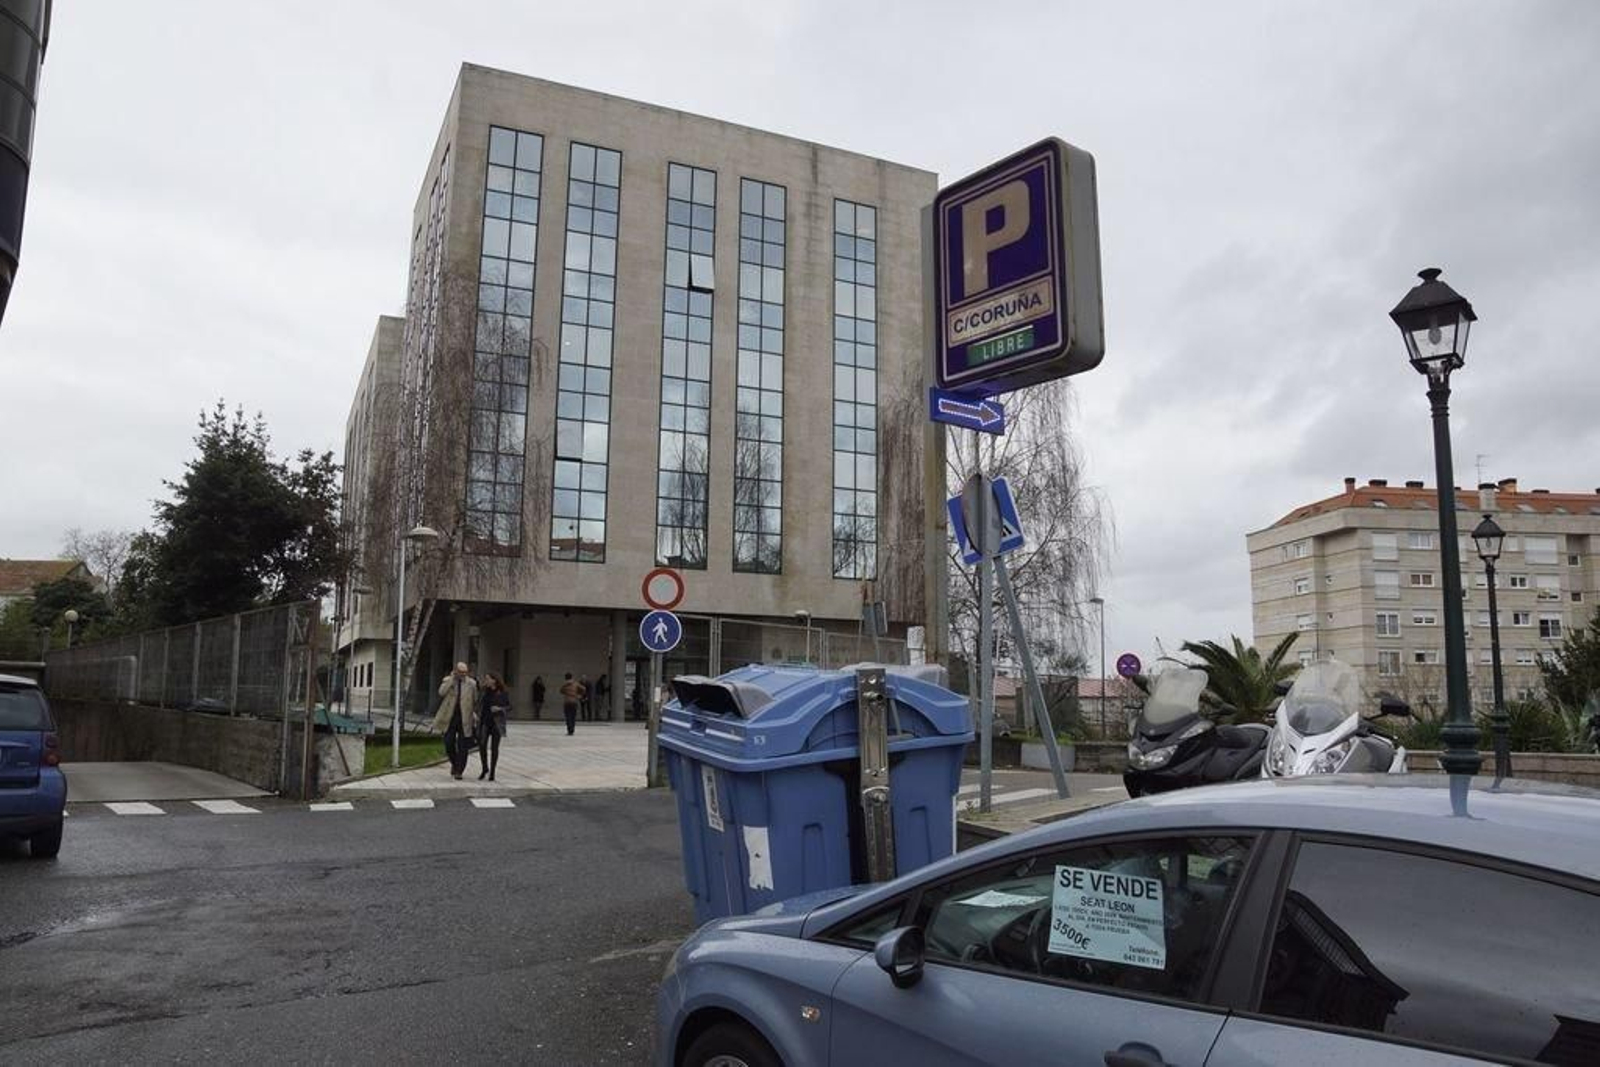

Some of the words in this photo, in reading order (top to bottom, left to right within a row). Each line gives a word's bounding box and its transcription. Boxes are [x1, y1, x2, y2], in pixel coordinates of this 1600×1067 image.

[962, 179, 1030, 297] P
[953, 291, 1042, 333] C/CORUÑA
[982, 333, 1025, 360] LIBRE
[1060, 869, 1084, 889] SE
[1090, 873, 1158, 900] VENDE
[1081, 896, 1105, 908] SEAT
[1108, 901, 1135, 913] LEON
[1053, 918, 1091, 950] 3500€
